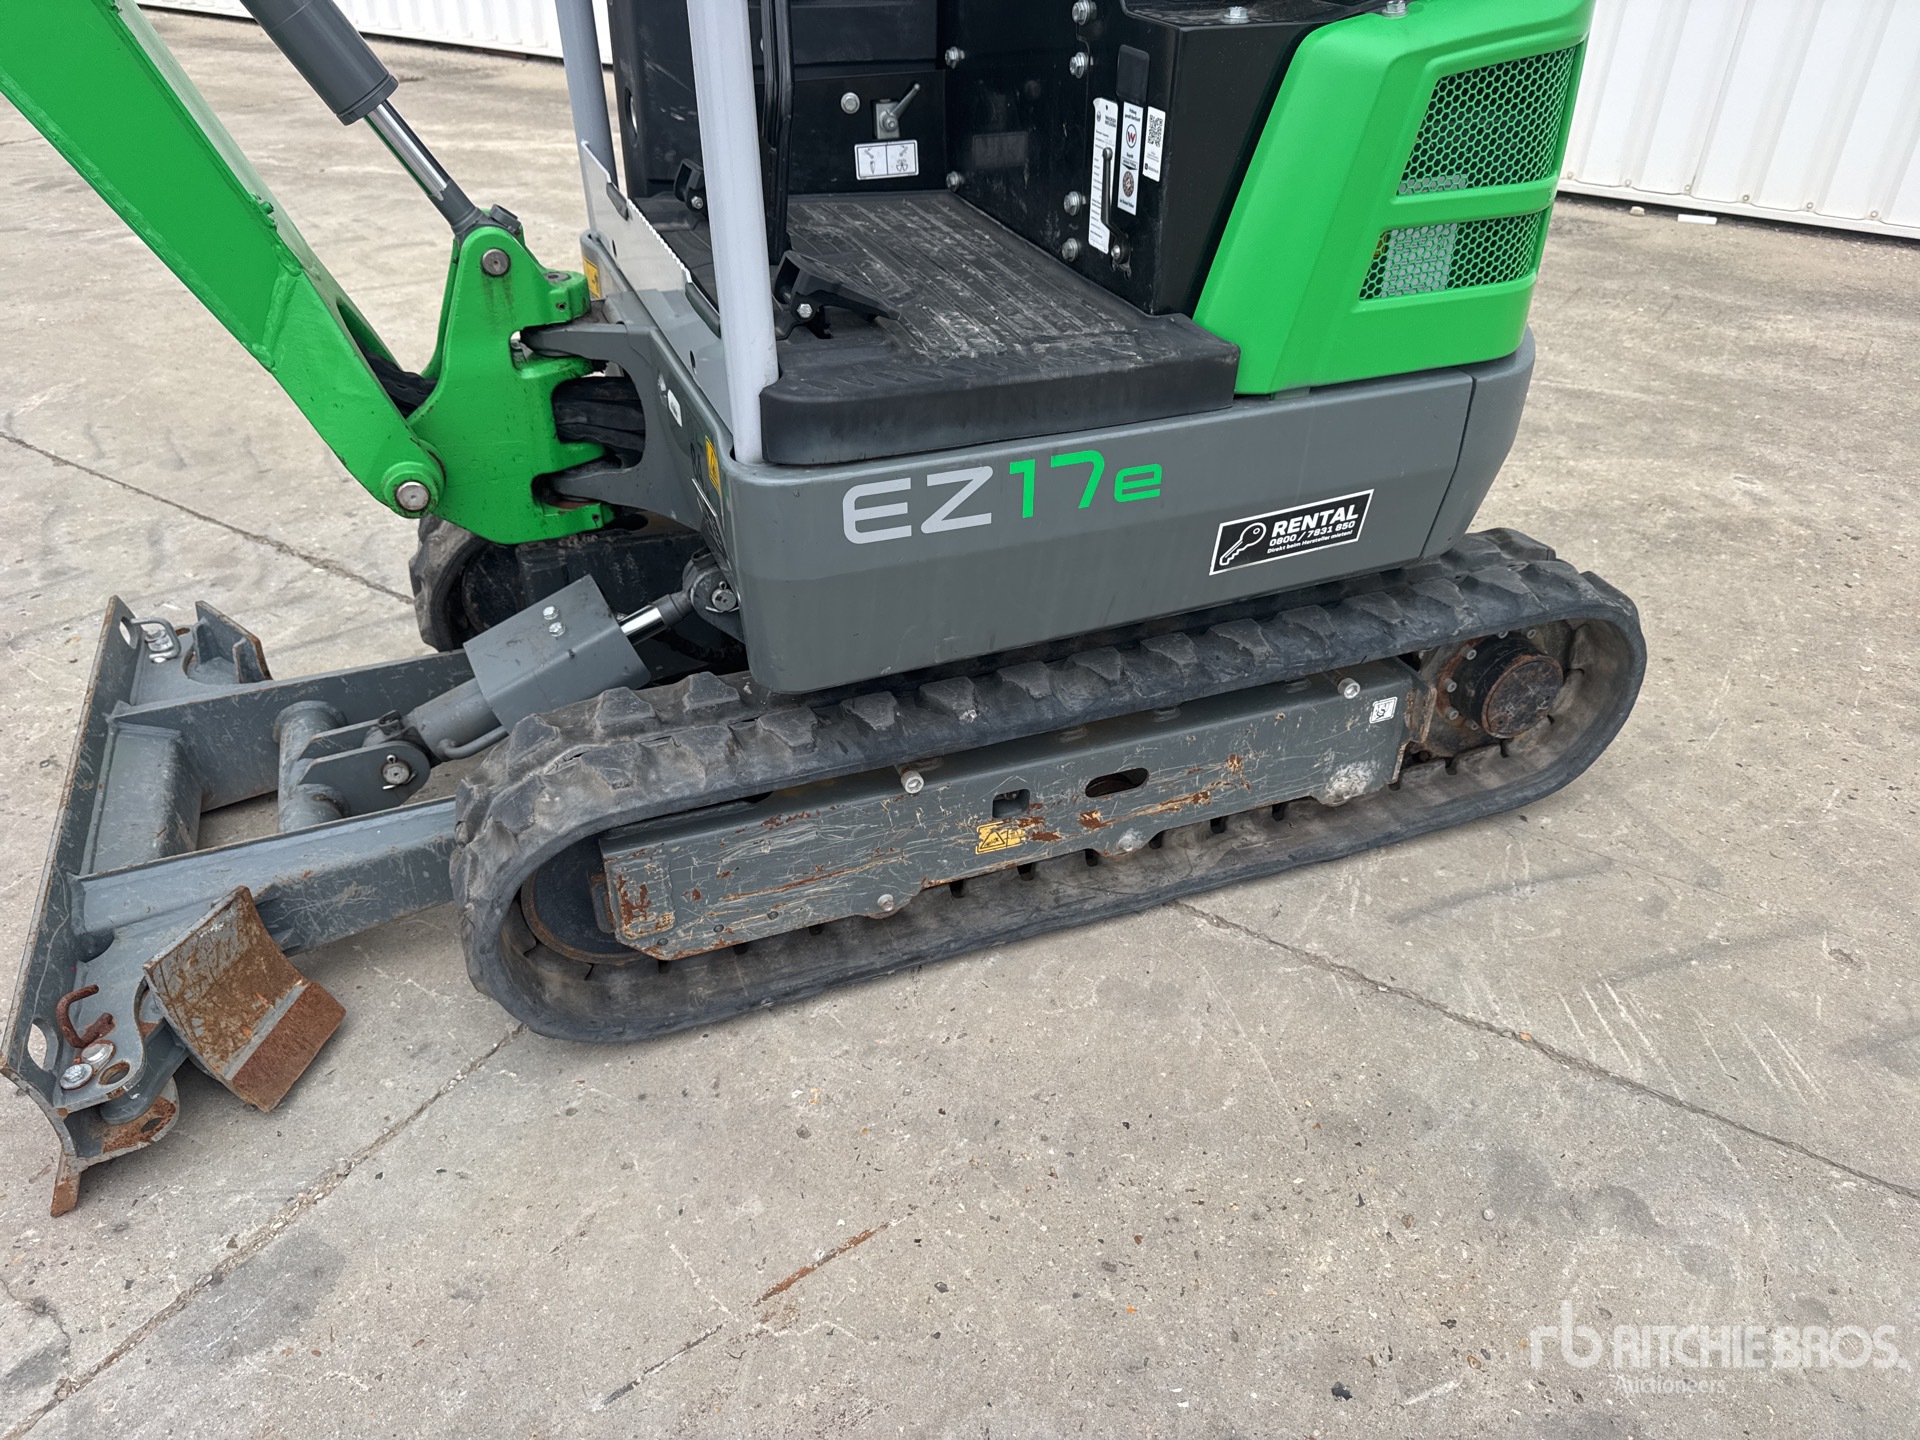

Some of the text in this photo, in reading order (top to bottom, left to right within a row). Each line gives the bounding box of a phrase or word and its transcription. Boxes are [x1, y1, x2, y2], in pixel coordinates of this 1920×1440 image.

[842, 450, 1162, 544] EZ17e
[1269, 534, 1297, 547] 0800
[1308, 526, 1333, 538] 7831
[1335, 521, 1355, 532] 850
[1271, 504, 1359, 538] RENTAL
[1267, 545, 1286, 554] Direkt
[1302, 536, 1330, 545] Hersteller
[1331, 530, 1353, 539] mieten!
